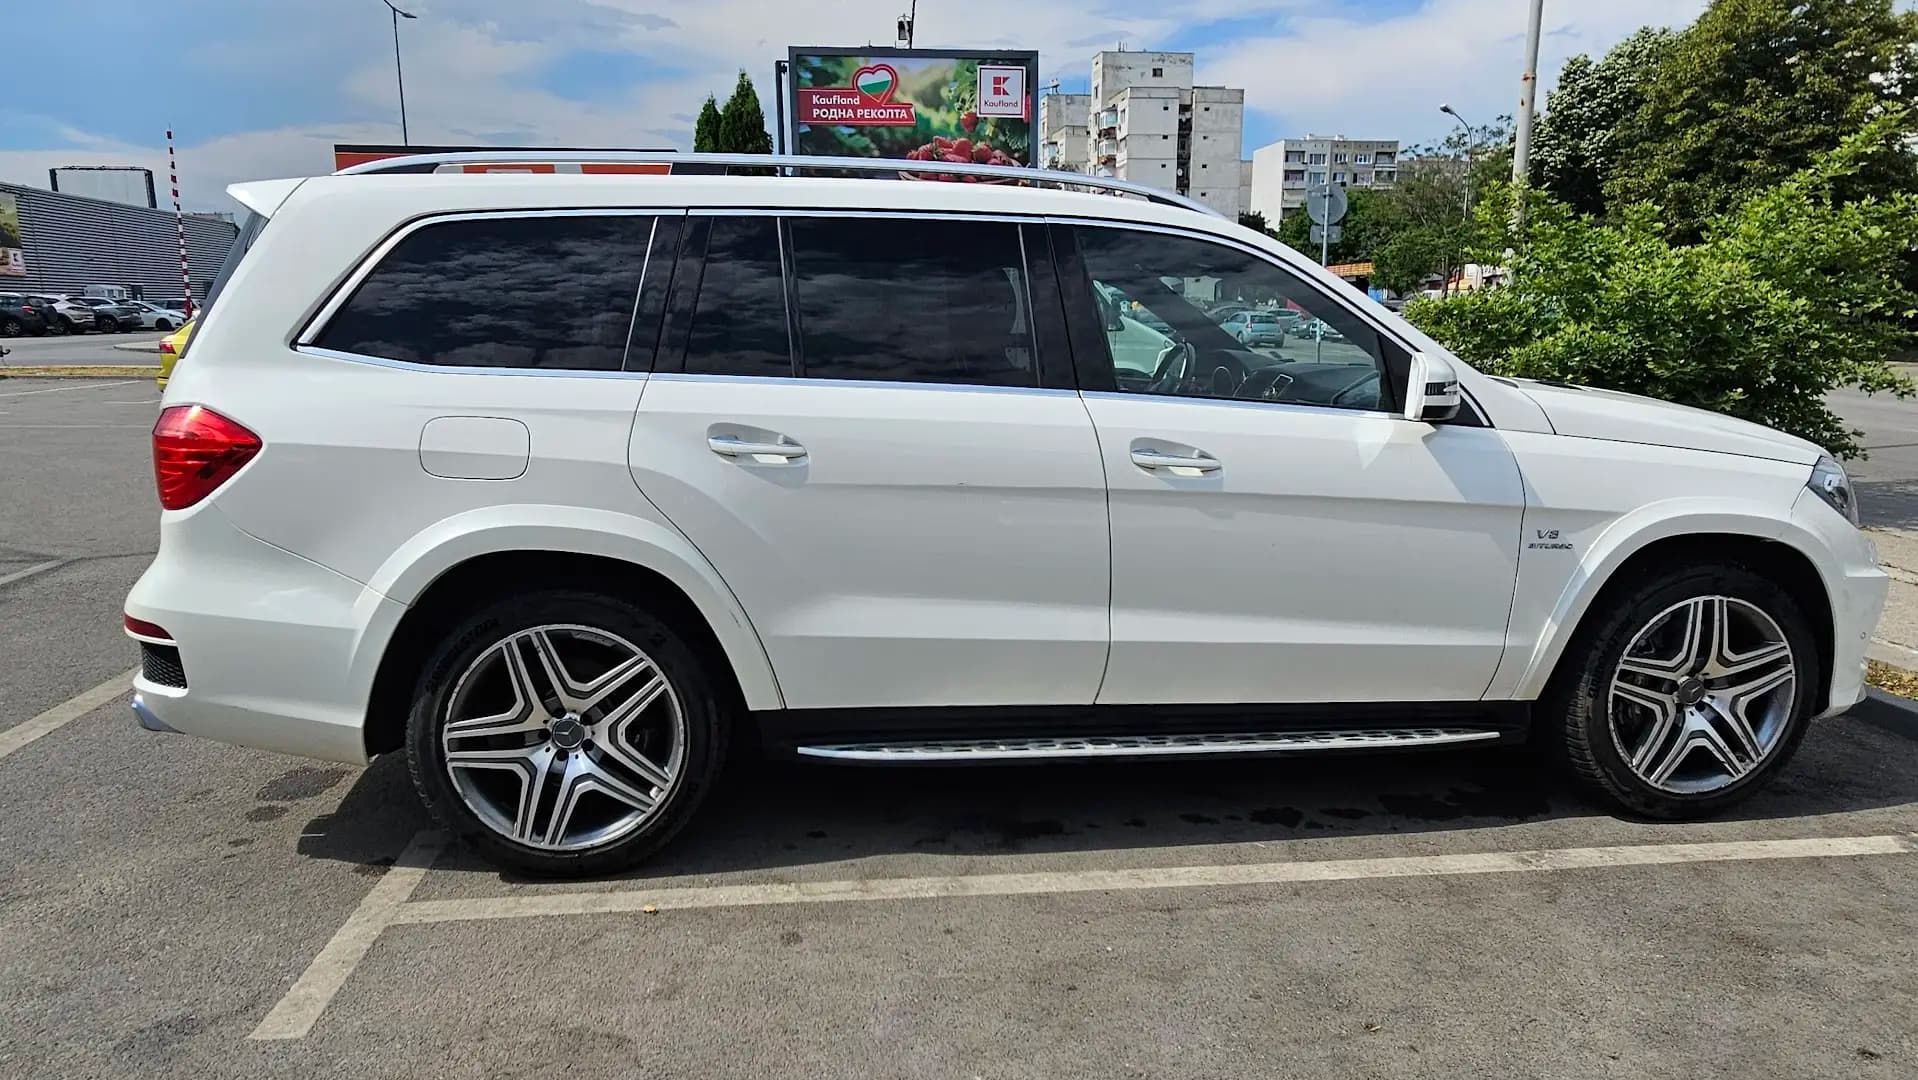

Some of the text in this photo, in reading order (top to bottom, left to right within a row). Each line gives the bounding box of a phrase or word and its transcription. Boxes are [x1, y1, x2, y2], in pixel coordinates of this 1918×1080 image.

[812, 94, 860, 105] Kaufland
[813, 108, 908, 120] РОДНА РЕКОЛТА
[1537, 530, 1559, 539] V8
